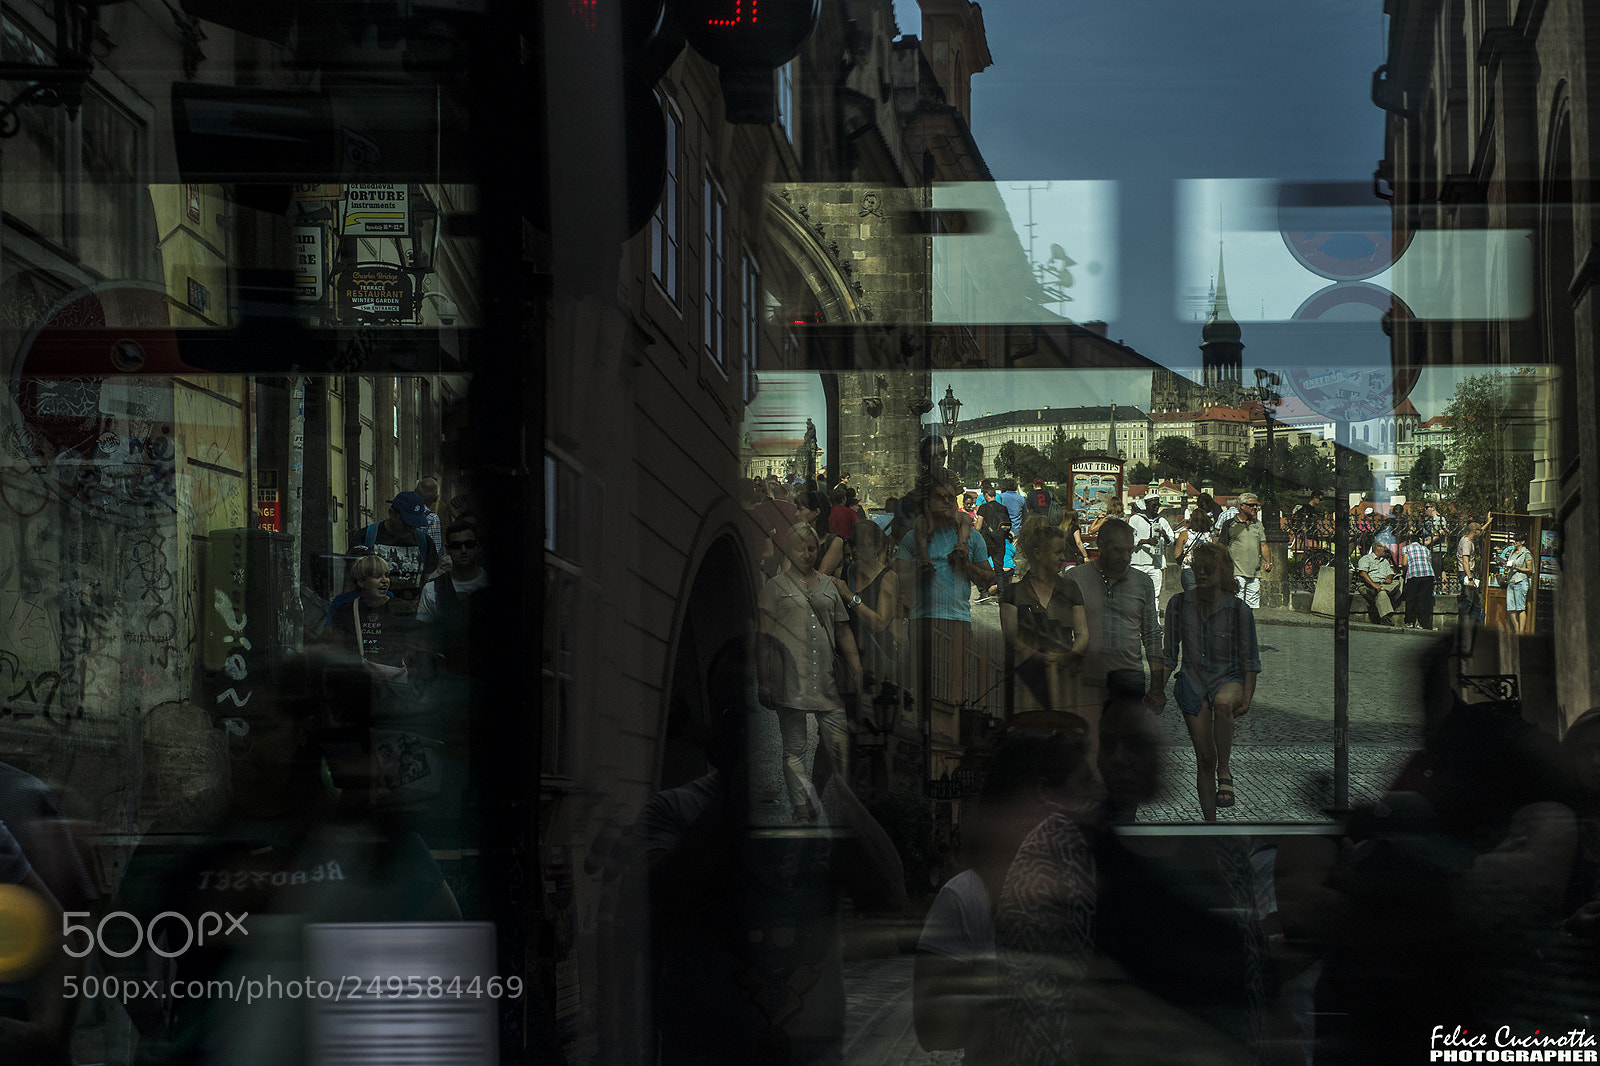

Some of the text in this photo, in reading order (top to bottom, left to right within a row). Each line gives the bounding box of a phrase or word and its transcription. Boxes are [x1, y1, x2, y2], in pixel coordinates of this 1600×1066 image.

[351, 201, 396, 209] instruments
[346, 289, 404, 298] RESTAURANT
[1095, 463, 1119, 471] TRIPS
